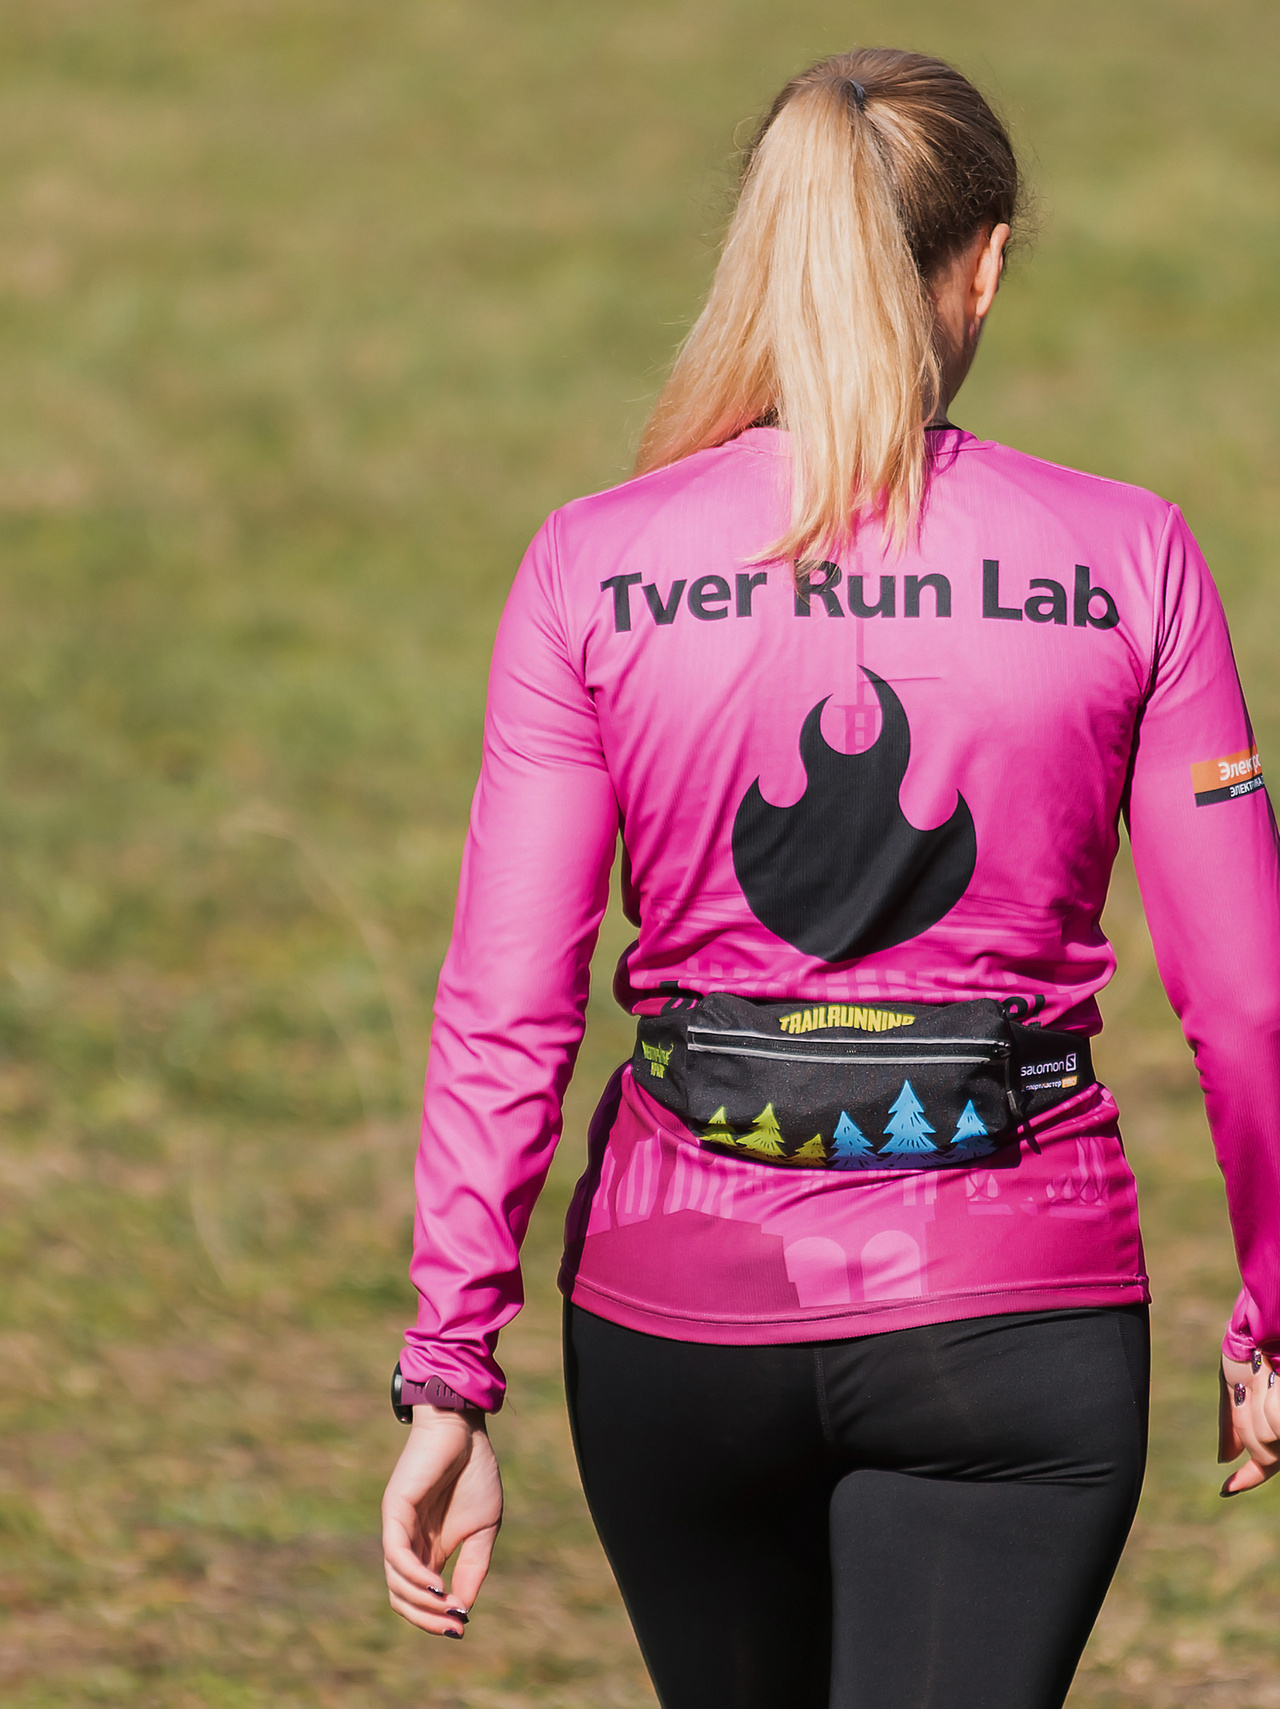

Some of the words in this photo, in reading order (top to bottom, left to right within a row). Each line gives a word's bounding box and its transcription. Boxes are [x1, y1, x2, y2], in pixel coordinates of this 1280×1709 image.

[600, 570, 767, 634] Tver
[793, 558, 952, 619] Run
[981, 559, 1120, 631] Lab
[779, 1005, 916, 1034] TRAILRUNNING
[1020, 1060, 1065, 1077] salomon
